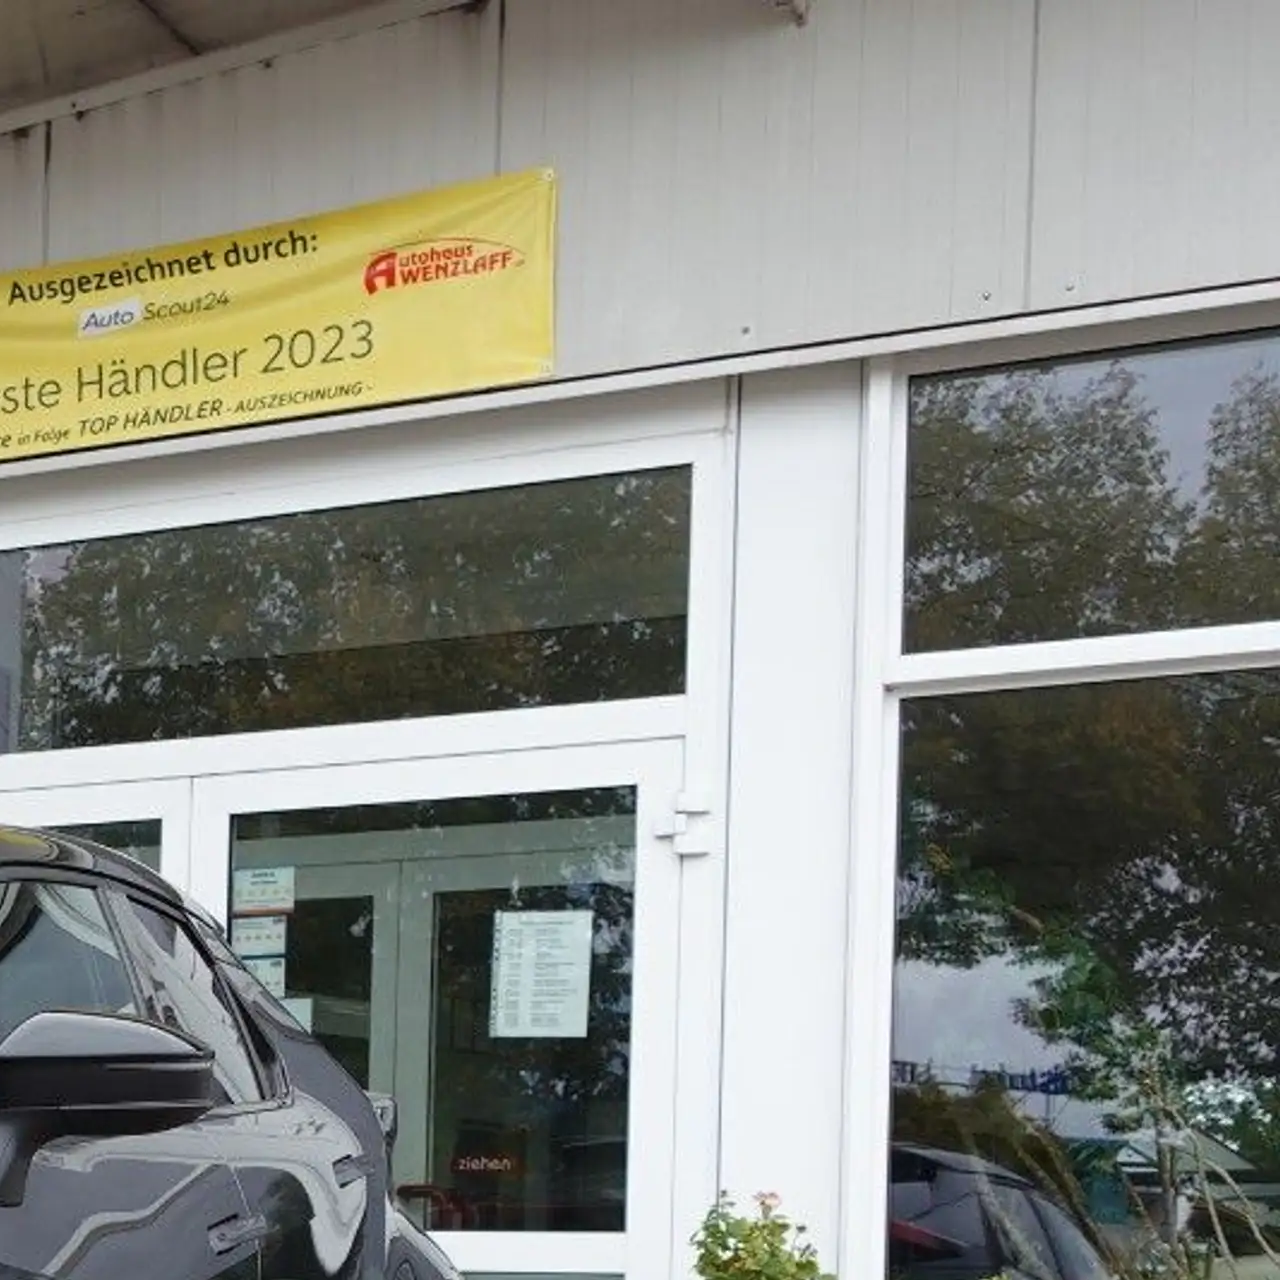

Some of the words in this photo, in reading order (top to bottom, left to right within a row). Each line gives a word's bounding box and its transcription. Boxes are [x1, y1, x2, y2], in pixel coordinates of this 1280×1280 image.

[7, 249, 216, 306] Ausgezeichnet
[224, 230, 318, 267] durch:
[76, 347, 248, 402] Händler
[261, 319, 374, 373] 2023
[79, 415, 119, 437] TOP
